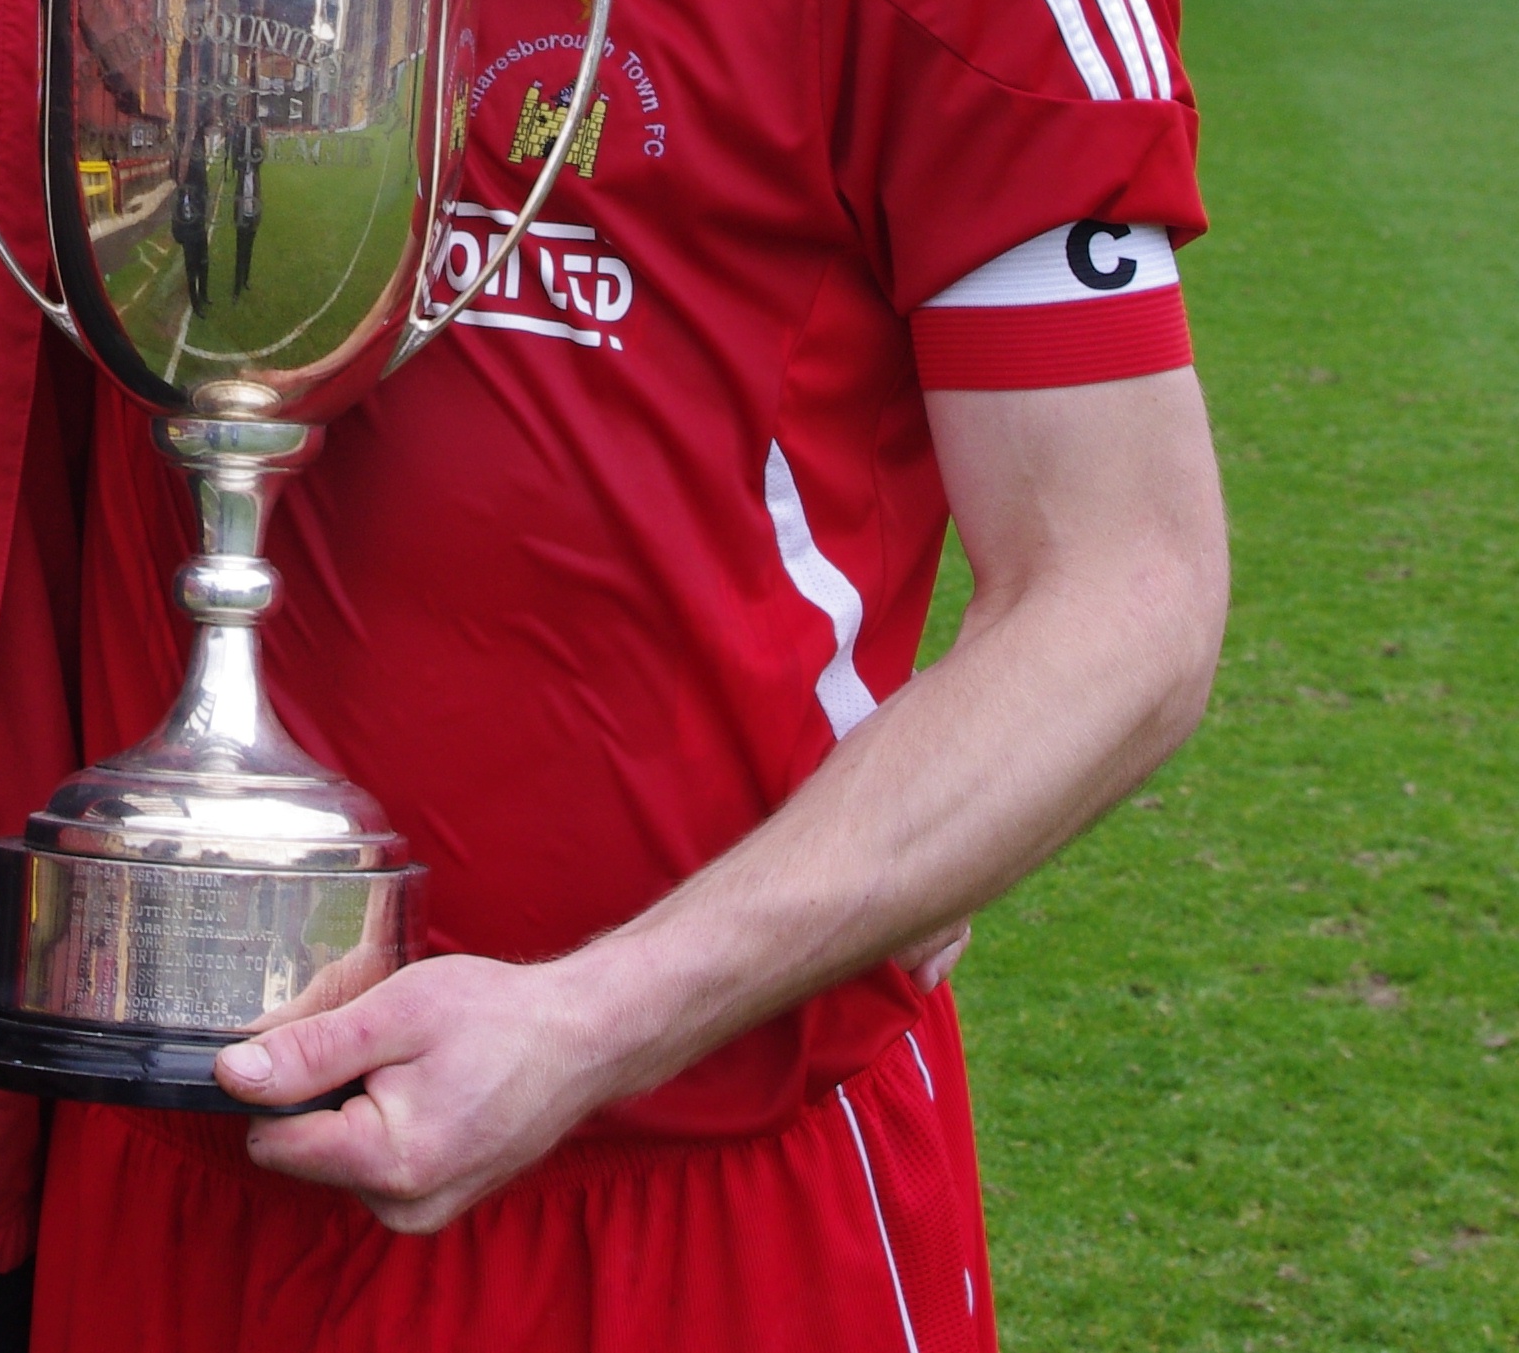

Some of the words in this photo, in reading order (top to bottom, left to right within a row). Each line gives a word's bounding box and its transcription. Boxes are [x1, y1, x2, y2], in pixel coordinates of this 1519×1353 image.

[470, 32, 615, 117] naresborouh
[620, 50, 660, 114] Town
[642, 123, 666, 158] FC
[1065, 219, 1138, 291] C
[126, 867, 170, 885] SSETT
[176, 870, 222, 887] ALBION
[198, 887, 239, 906] TOWN
[185, 905, 228, 923] TOWN
[127, 947, 238, 973] BRIDLINGTON
[193, 969, 232, 988] TOWN
[127, 980, 203, 1002] GUISELEY
[124, 995, 166, 1010] NORTH
[172, 997, 229, 1015] SHIELDS
[123, 1008, 210, 1027] SPENNYMOOR
